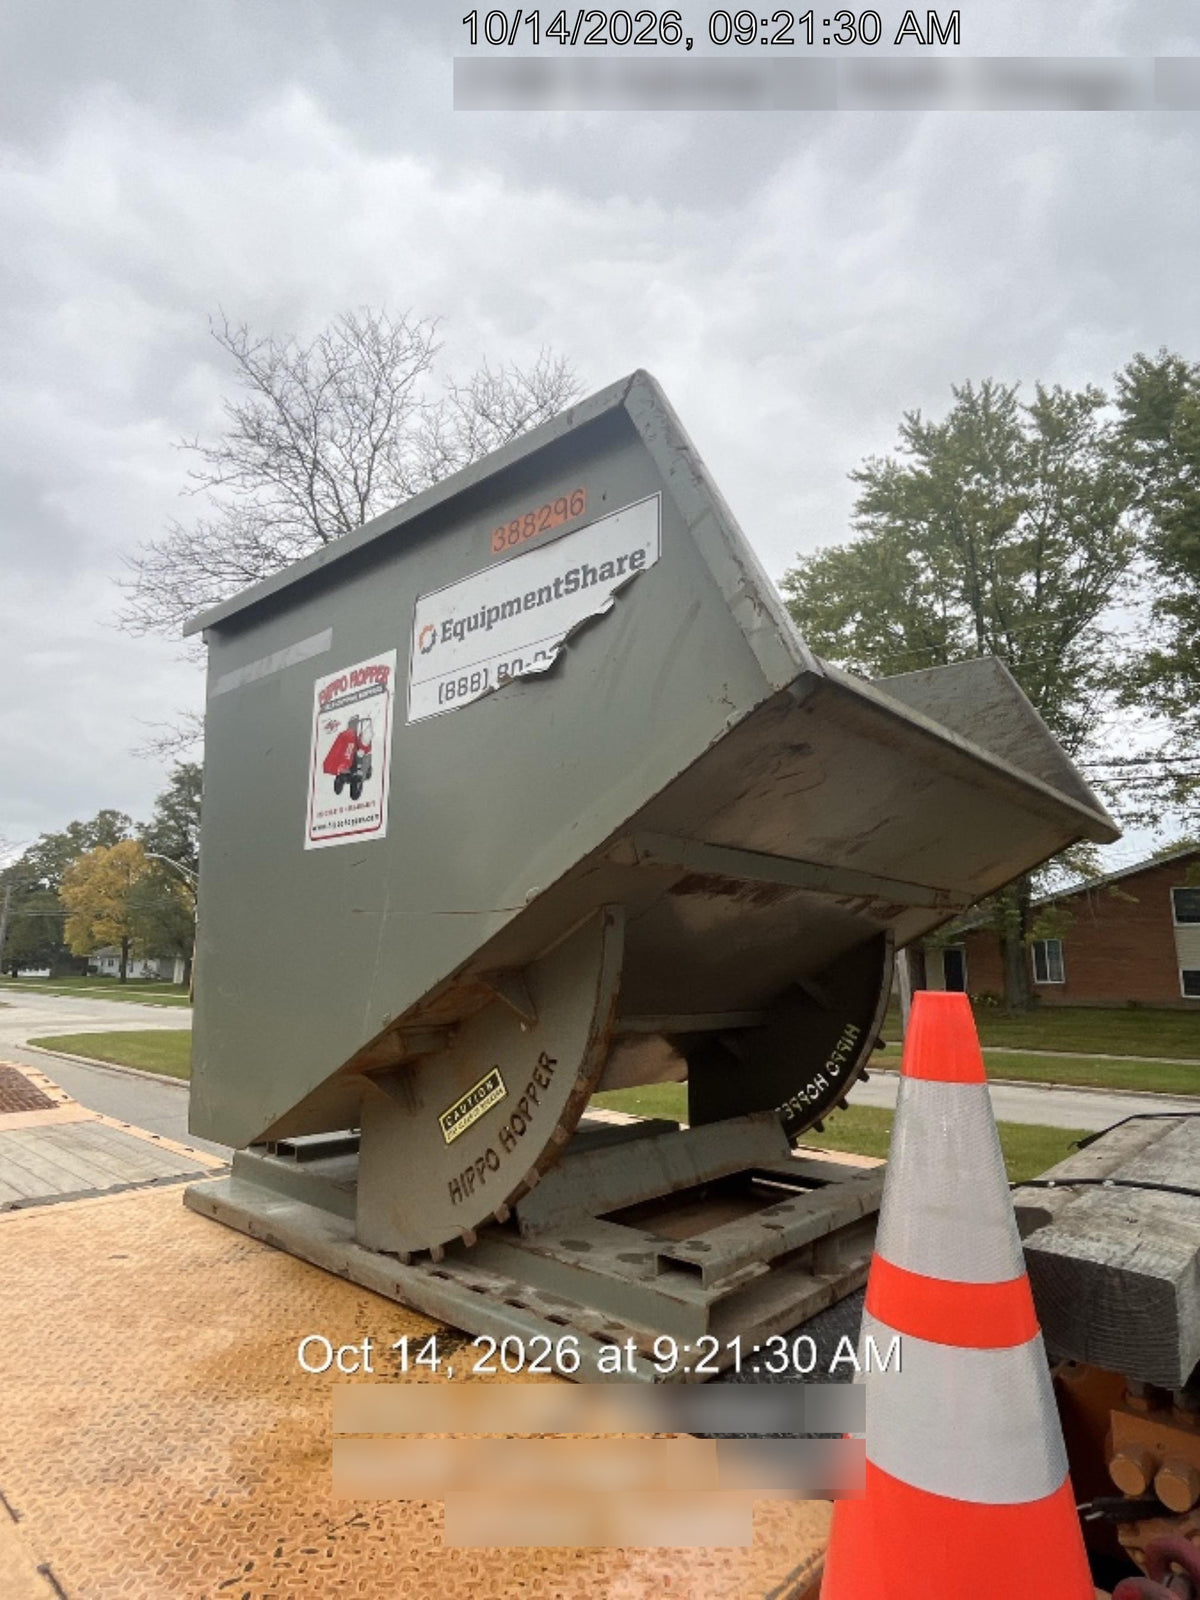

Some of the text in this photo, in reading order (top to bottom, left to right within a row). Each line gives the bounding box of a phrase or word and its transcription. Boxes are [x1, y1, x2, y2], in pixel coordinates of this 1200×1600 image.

[492, 488, 586, 553] 388296
[440, 548, 646, 643] EquipmentShare
[319, 676, 348, 703] HIPPO
[350, 665, 390, 689] HOPPER
[437, 668, 489, 704] (888)
[446, 1080, 495, 1127] CAUTION
[448, 1147, 501, 1206] HIPPO
[499, 1051, 558, 1153] HOPPER
